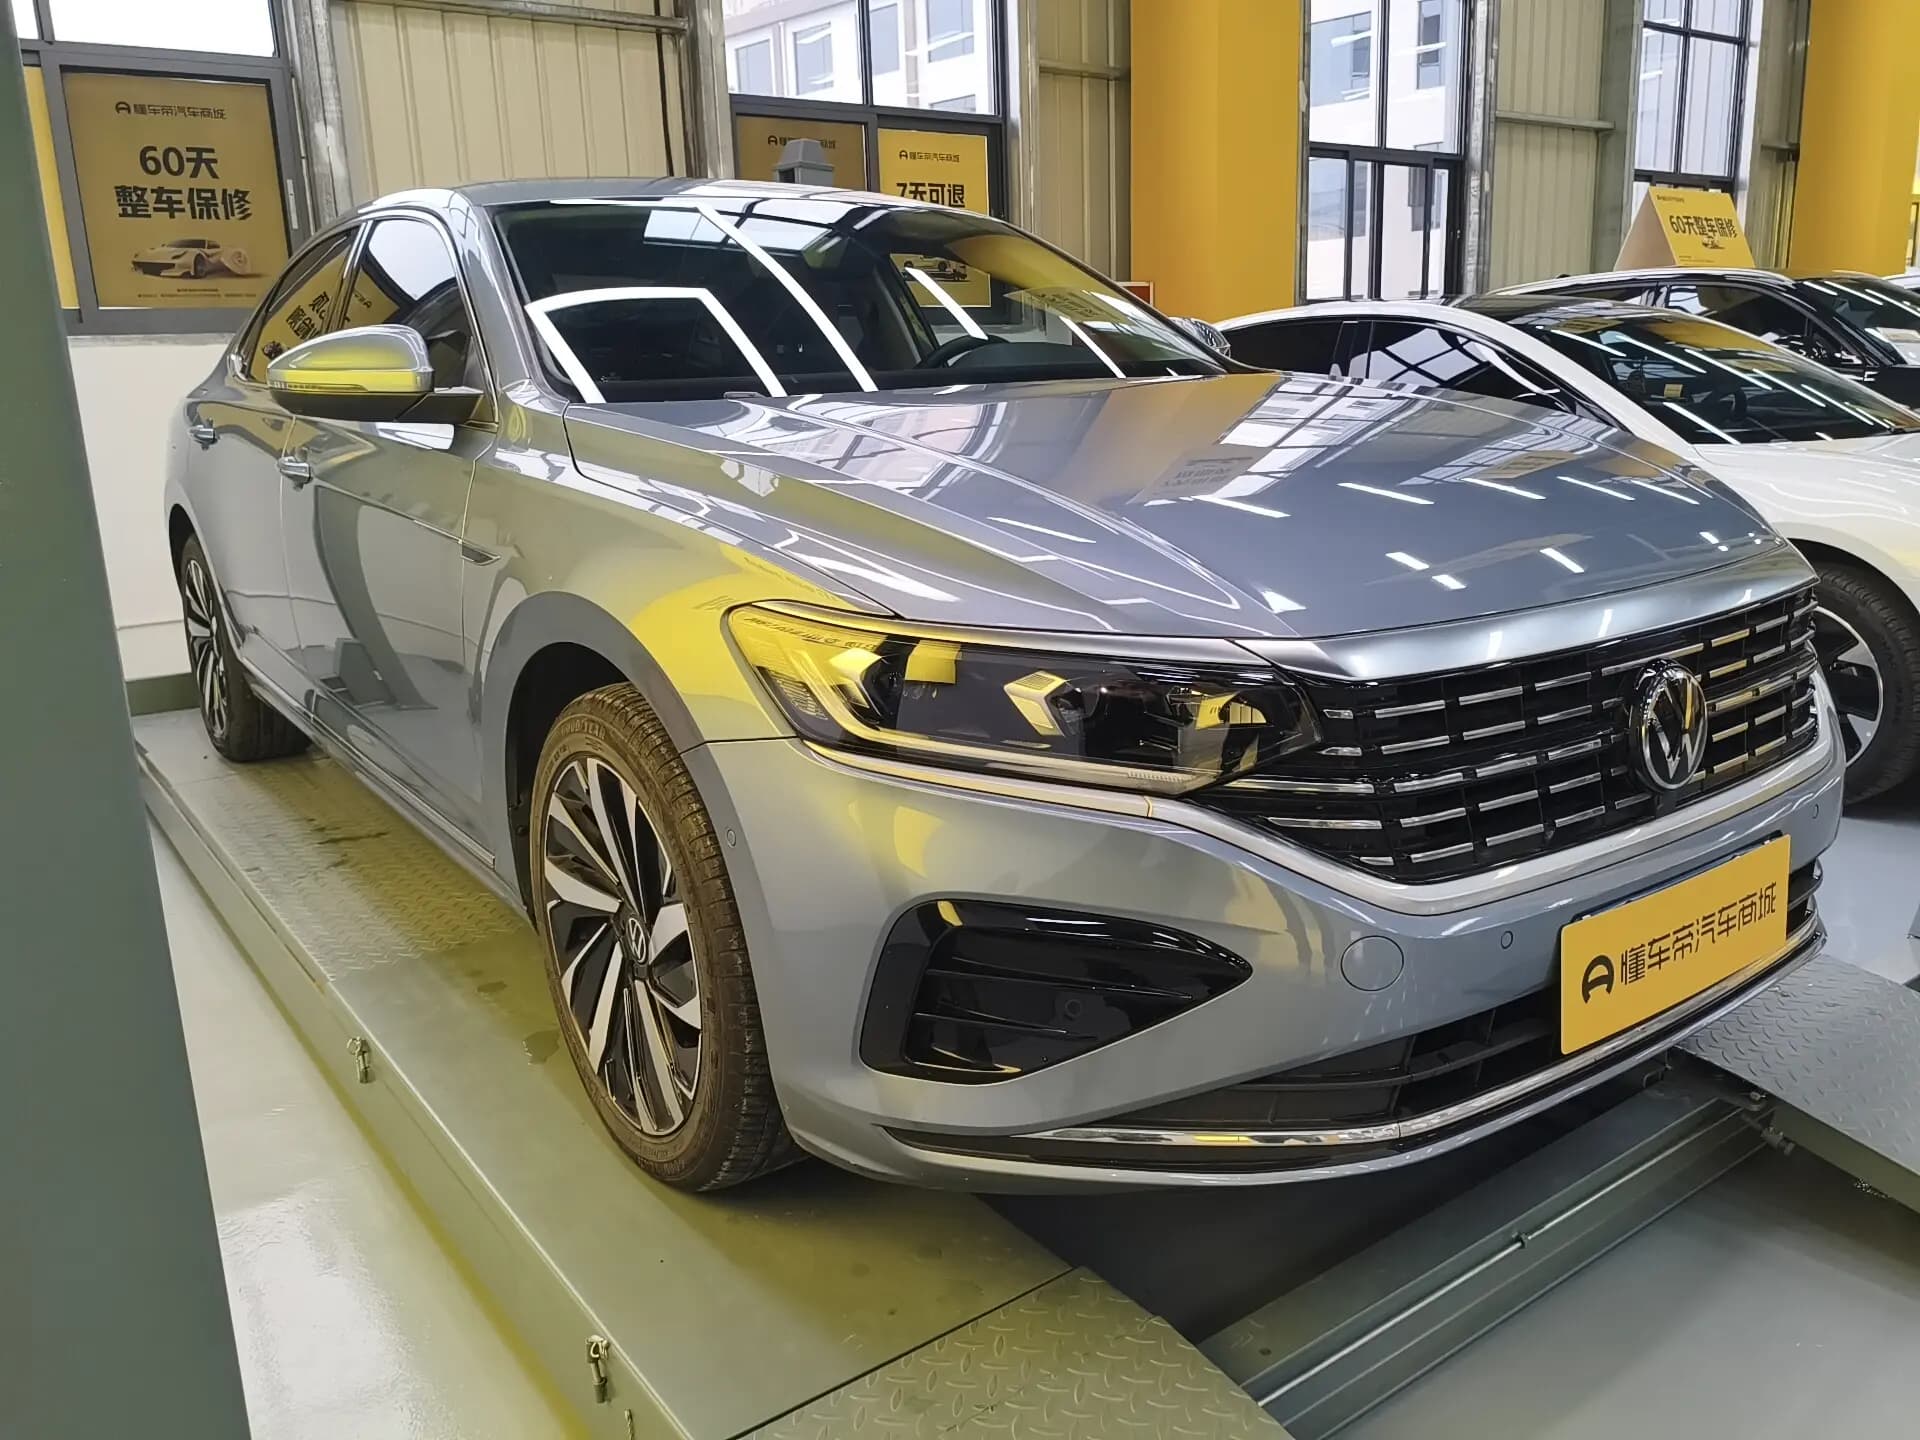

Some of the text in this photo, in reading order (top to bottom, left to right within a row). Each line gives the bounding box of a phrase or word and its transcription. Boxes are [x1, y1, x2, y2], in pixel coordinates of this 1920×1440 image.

[139, 145, 220, 179] 60天
[114, 184, 253, 221] 整车保修
[896, 182, 965, 208] 7天可退
[1669, 215, 1737, 238] 60天整车保修
[1620, 881, 1777, 986] 懂车帝汽车商城
